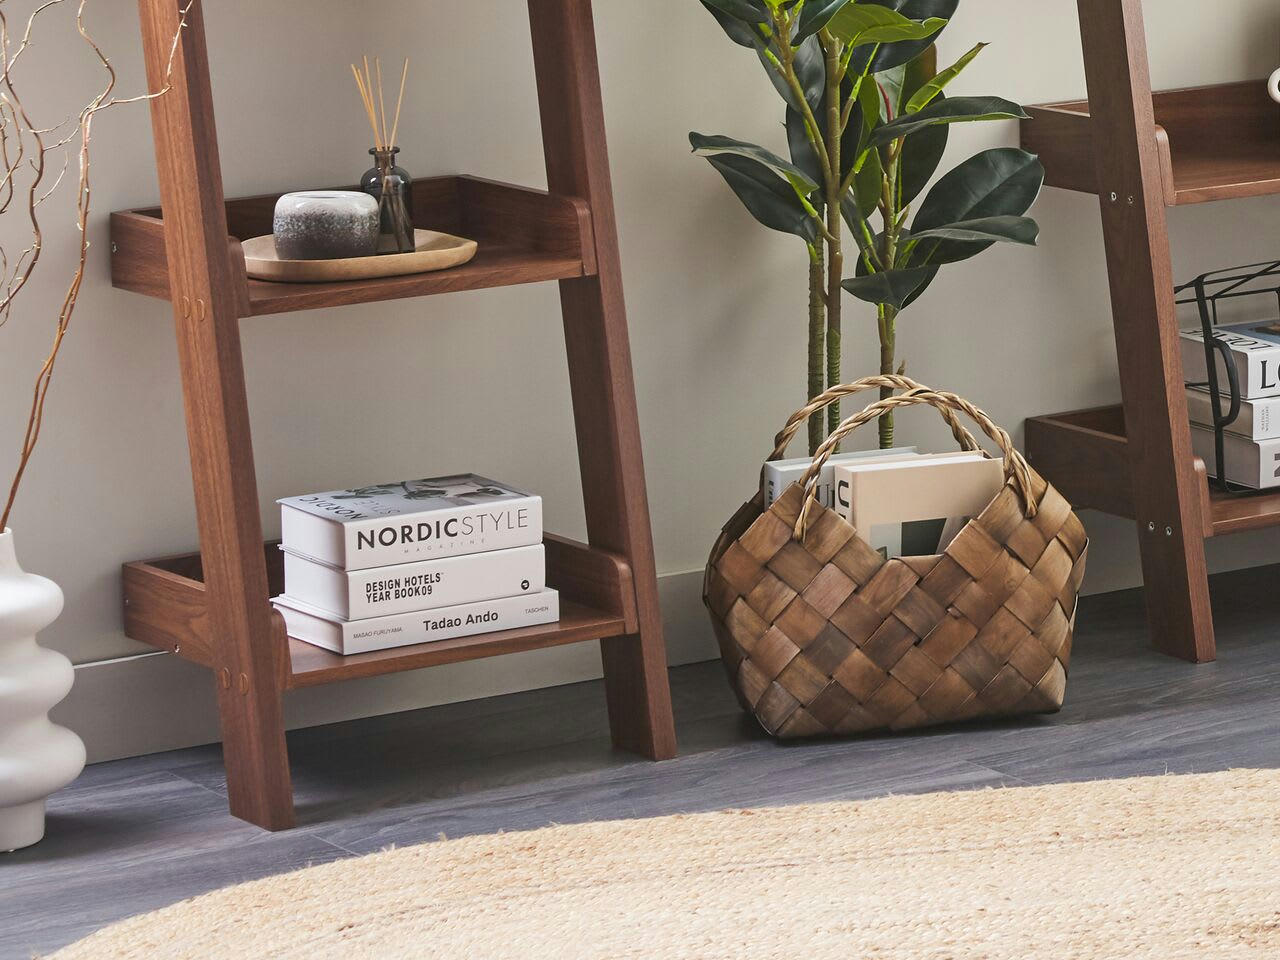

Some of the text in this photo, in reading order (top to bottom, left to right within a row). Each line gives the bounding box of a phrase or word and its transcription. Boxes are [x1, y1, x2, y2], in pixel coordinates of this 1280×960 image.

[365, 572, 442, 593] DESIGN HOTELS
[365, 590, 391, 604] YEAR
[422, 617, 462, 632] Tadao
[465, 610, 499, 625] Ando
